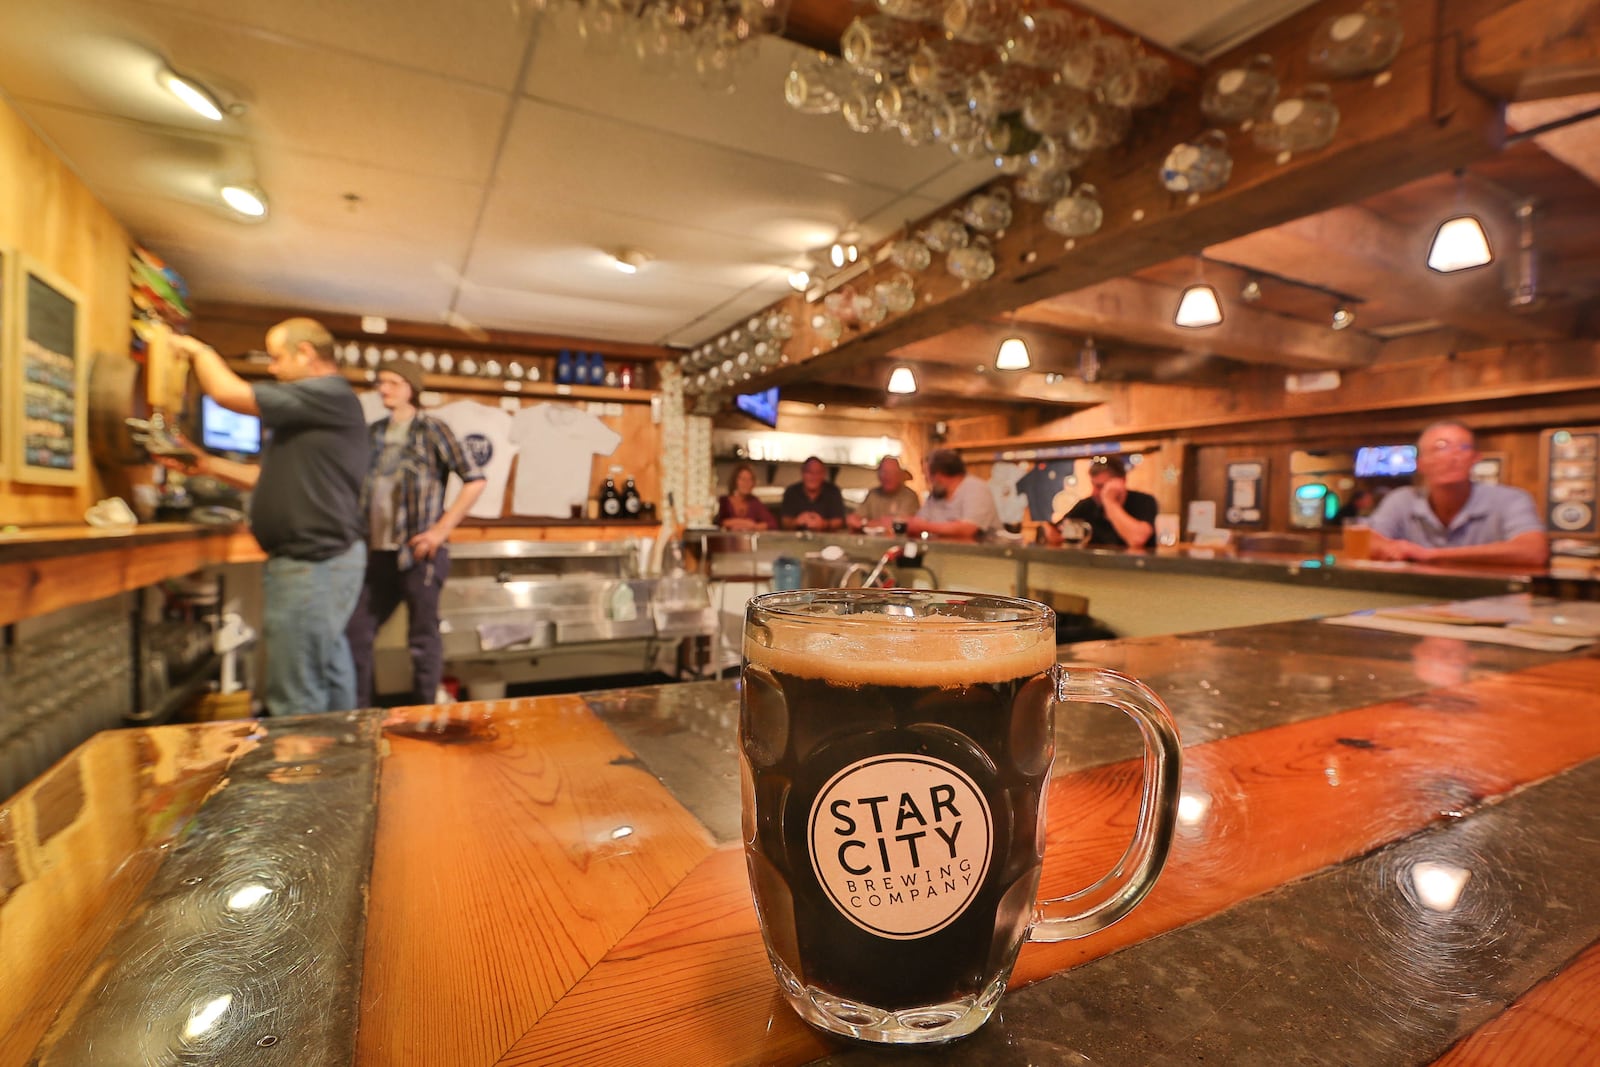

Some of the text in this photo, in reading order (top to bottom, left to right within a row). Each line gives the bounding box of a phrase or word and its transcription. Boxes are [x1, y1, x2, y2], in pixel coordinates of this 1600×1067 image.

[830, 784, 961, 836] STAR
[838, 821, 962, 875] CITY
[846, 859, 971, 892] BREWING
[851, 873, 971, 907] COMPANY
